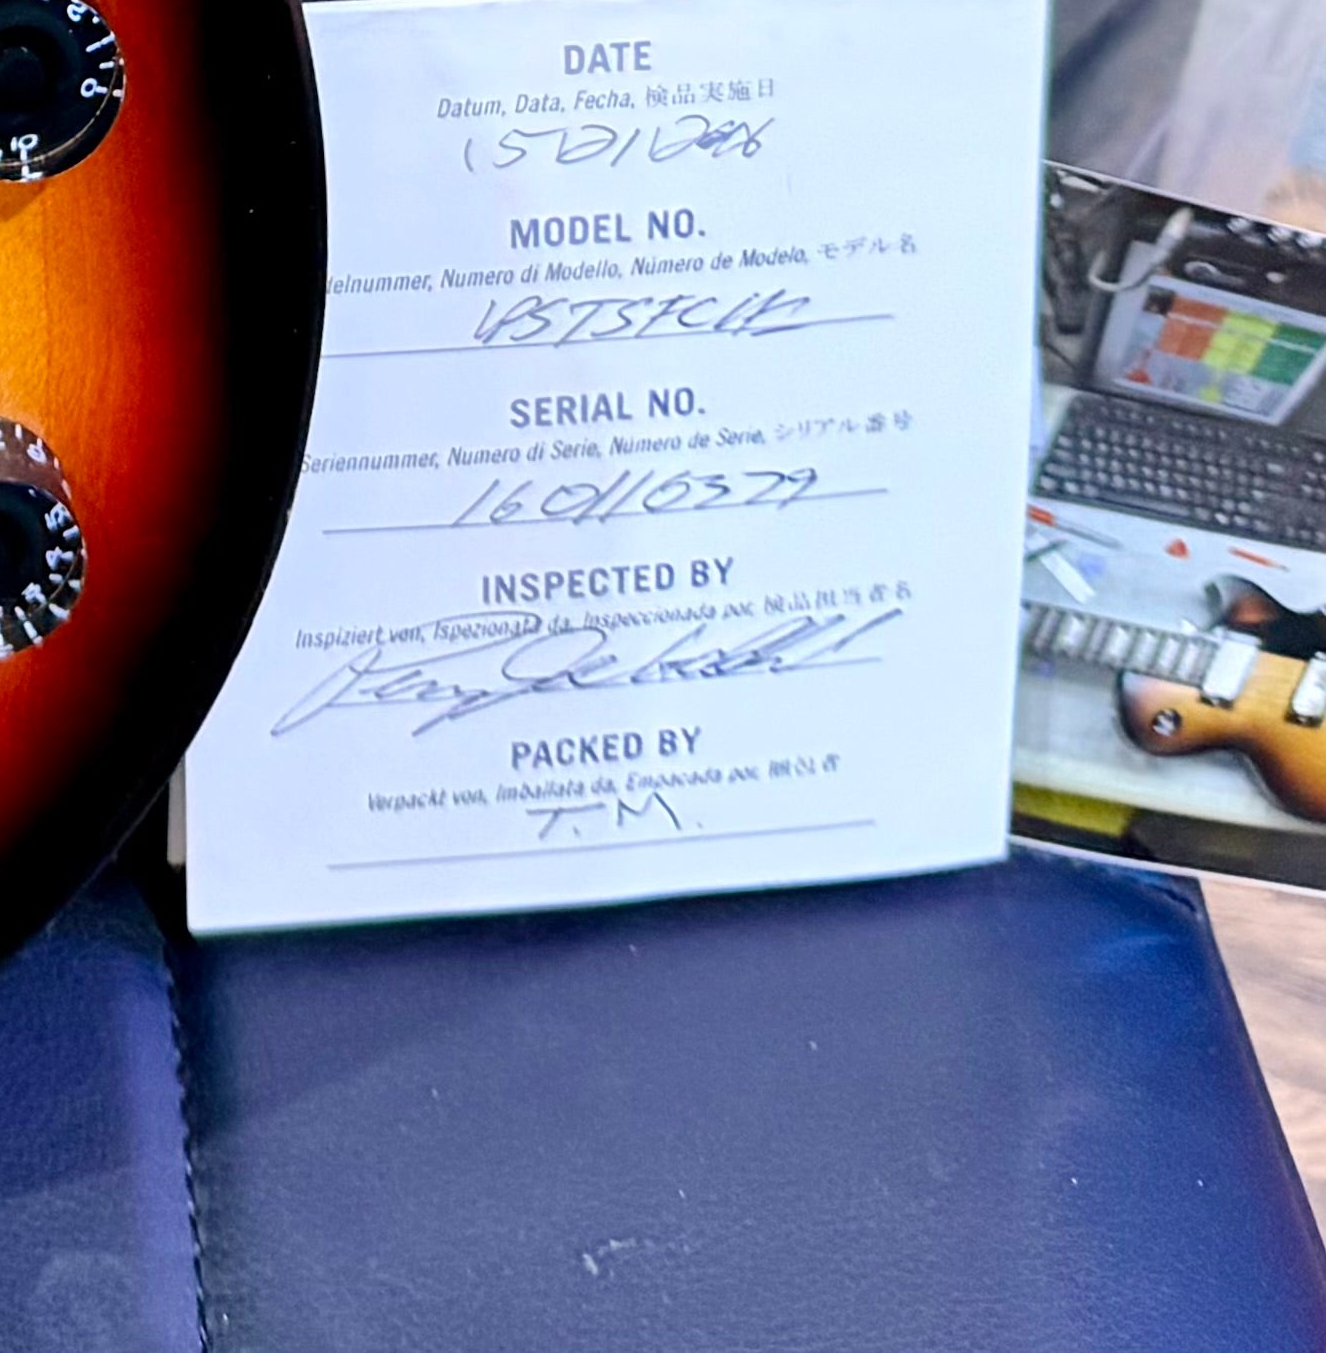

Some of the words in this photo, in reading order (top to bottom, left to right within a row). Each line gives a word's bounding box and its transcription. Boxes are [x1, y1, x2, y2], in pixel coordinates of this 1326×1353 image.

[564, 41, 652, 75] DATE
[437, 96, 506, 119] Datum,
[515, 92, 565, 114] Data,
[574, 88, 635, 112] Fecha,
[510, 213, 632, 249] MODEL
[648, 208, 706, 240] NO.
[440, 268, 514, 289] Numero
[520, 263, 539, 284] di
[544, 257, 623, 282] Modello,
[710, 251, 733, 271] de
[738, 246, 809, 269] Modelo,
[510, 391, 633, 428] SERIAL
[648, 387, 706, 418] NO.
[300, 451, 439, 474] Seriennummer,
[447, 445, 521, 467] Numero
[526, 441, 544, 461] di
[550, 436, 602, 460] Serie,
[688, 431, 710, 450] de
[483, 563, 675, 605] INSPECTED
[691, 556, 734, 589] BY
[296, 626, 384, 650] Inspiziert
[511, 732, 643, 770] PACKED
[658, 726, 701, 757] BY
